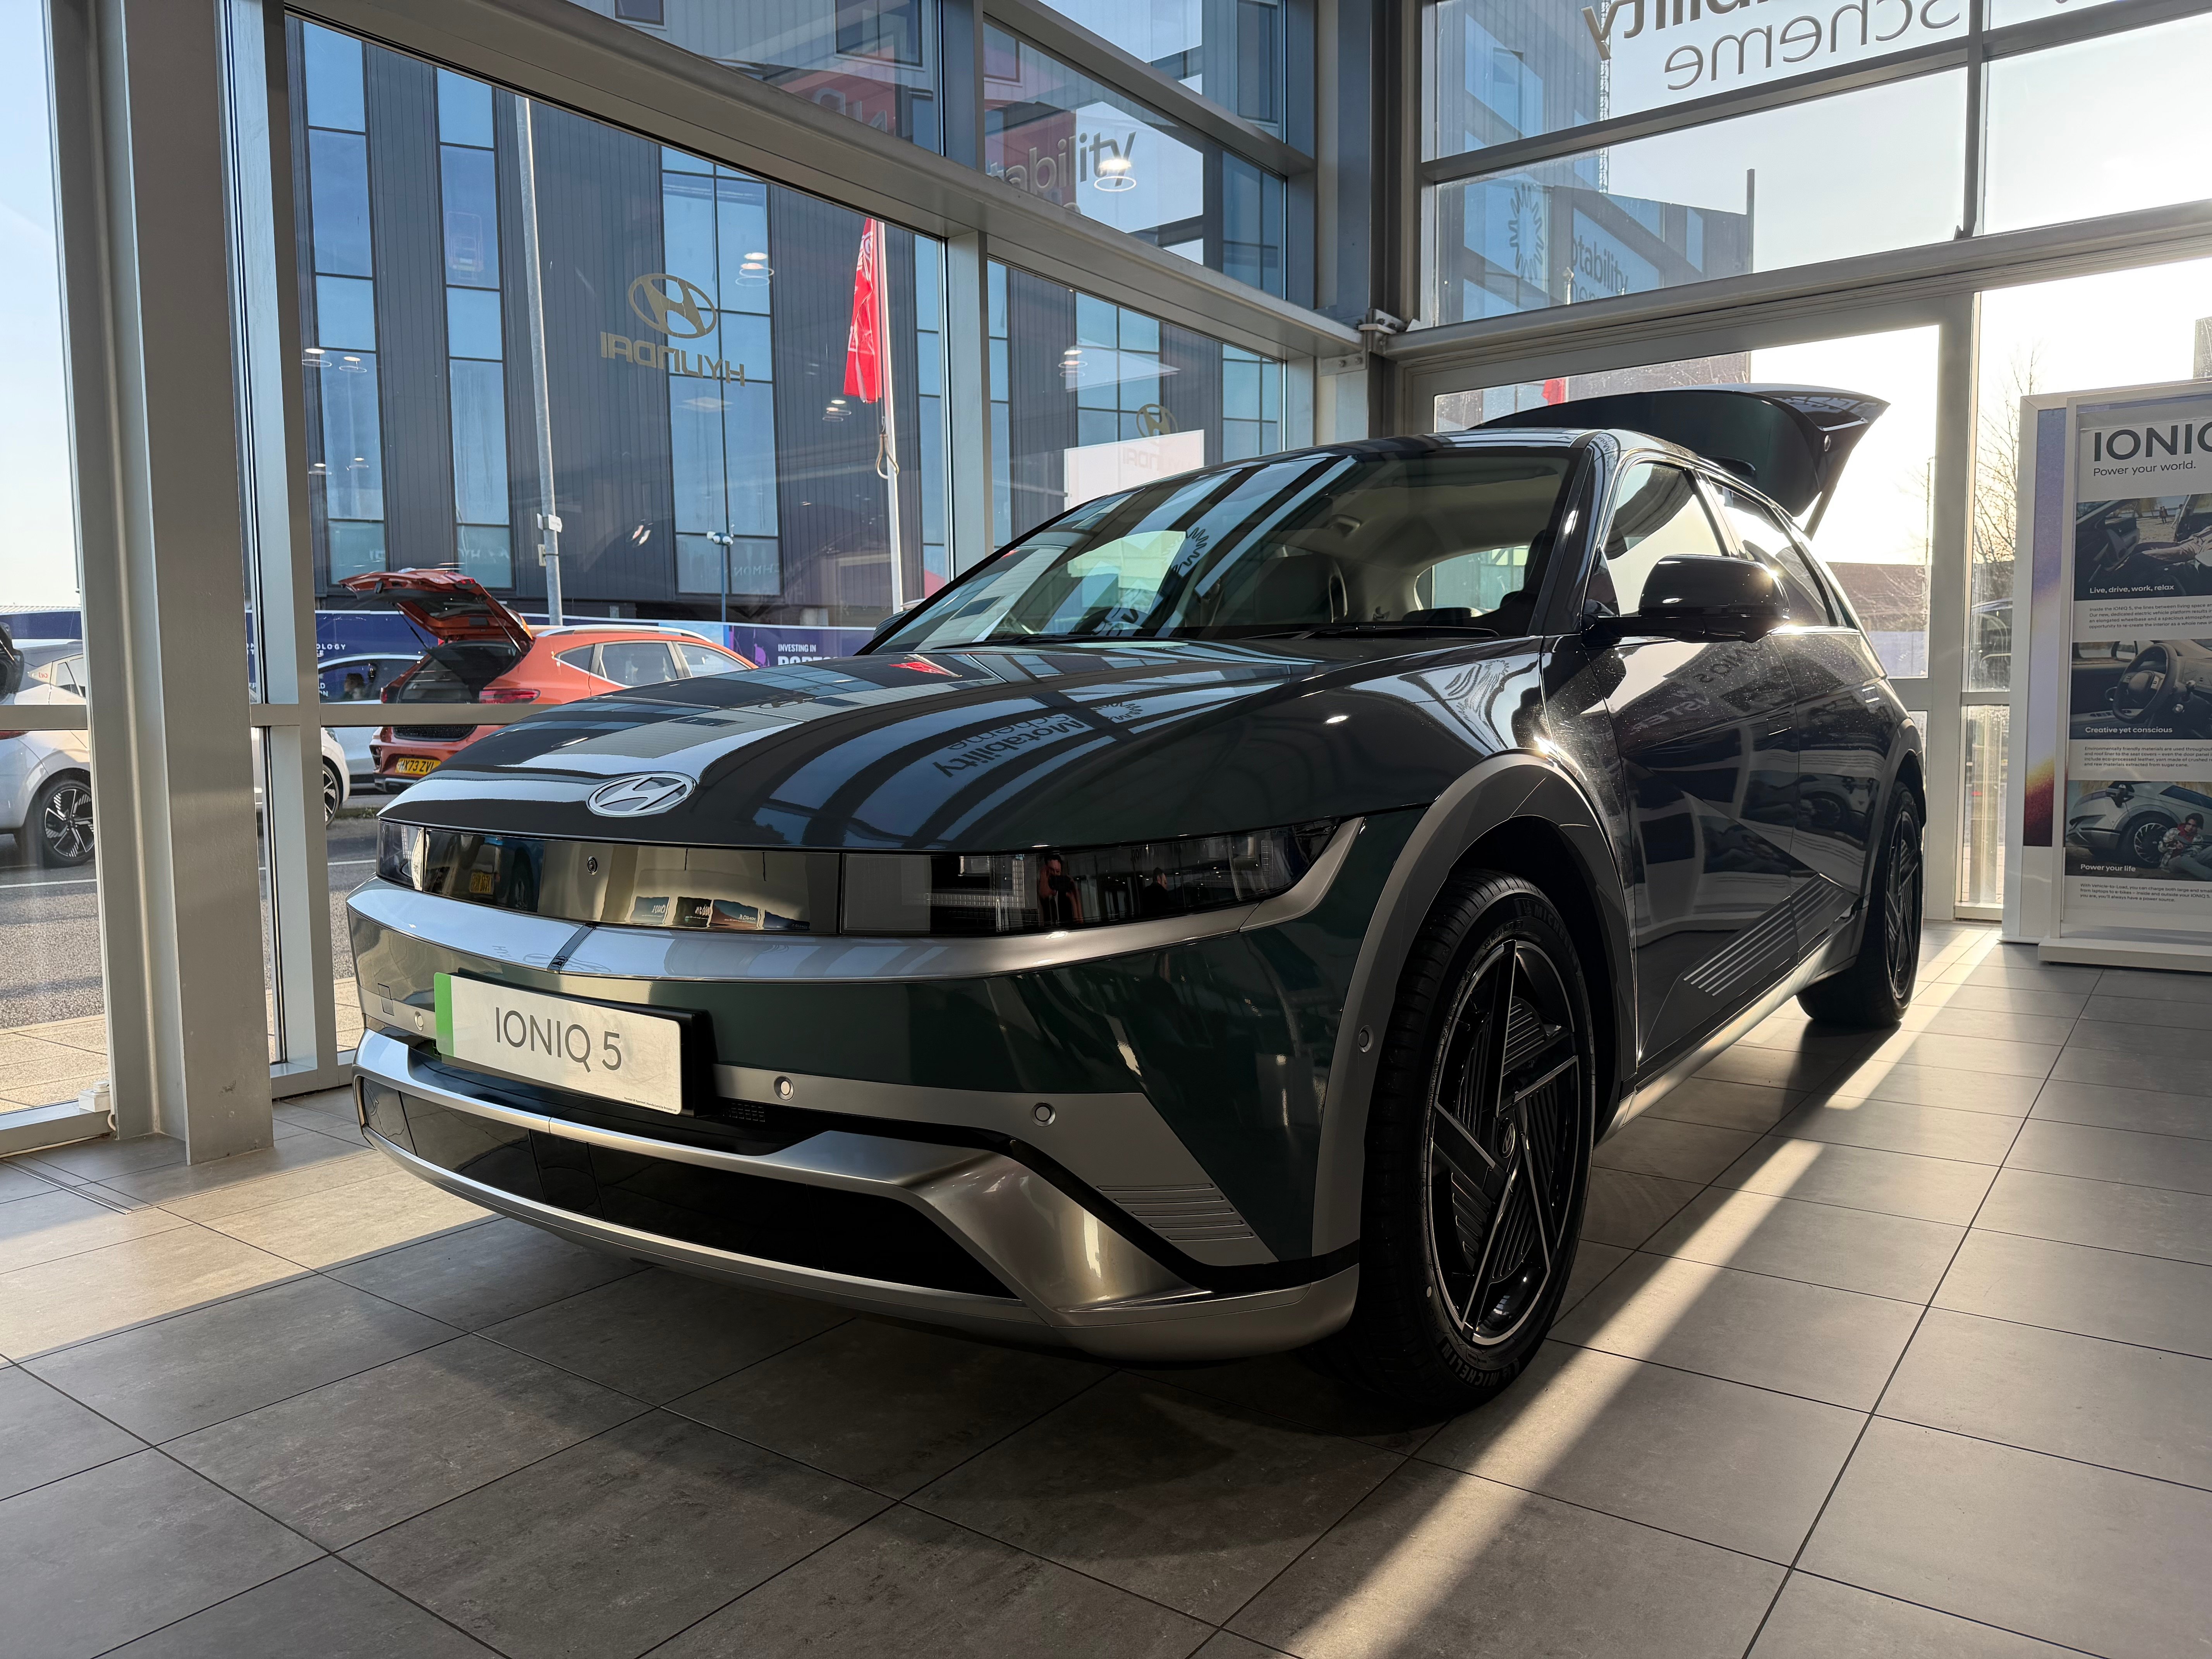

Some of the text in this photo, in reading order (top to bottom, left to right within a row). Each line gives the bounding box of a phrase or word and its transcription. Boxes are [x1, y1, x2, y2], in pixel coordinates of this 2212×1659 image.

[2094, 460, 2196, 476] Power your world.
[778, 644, 816, 652] INVESTING IN
[496, 1007, 621, 1073] IONIQ 5
[1441, 1343, 1499, 1386] MICHELIN
